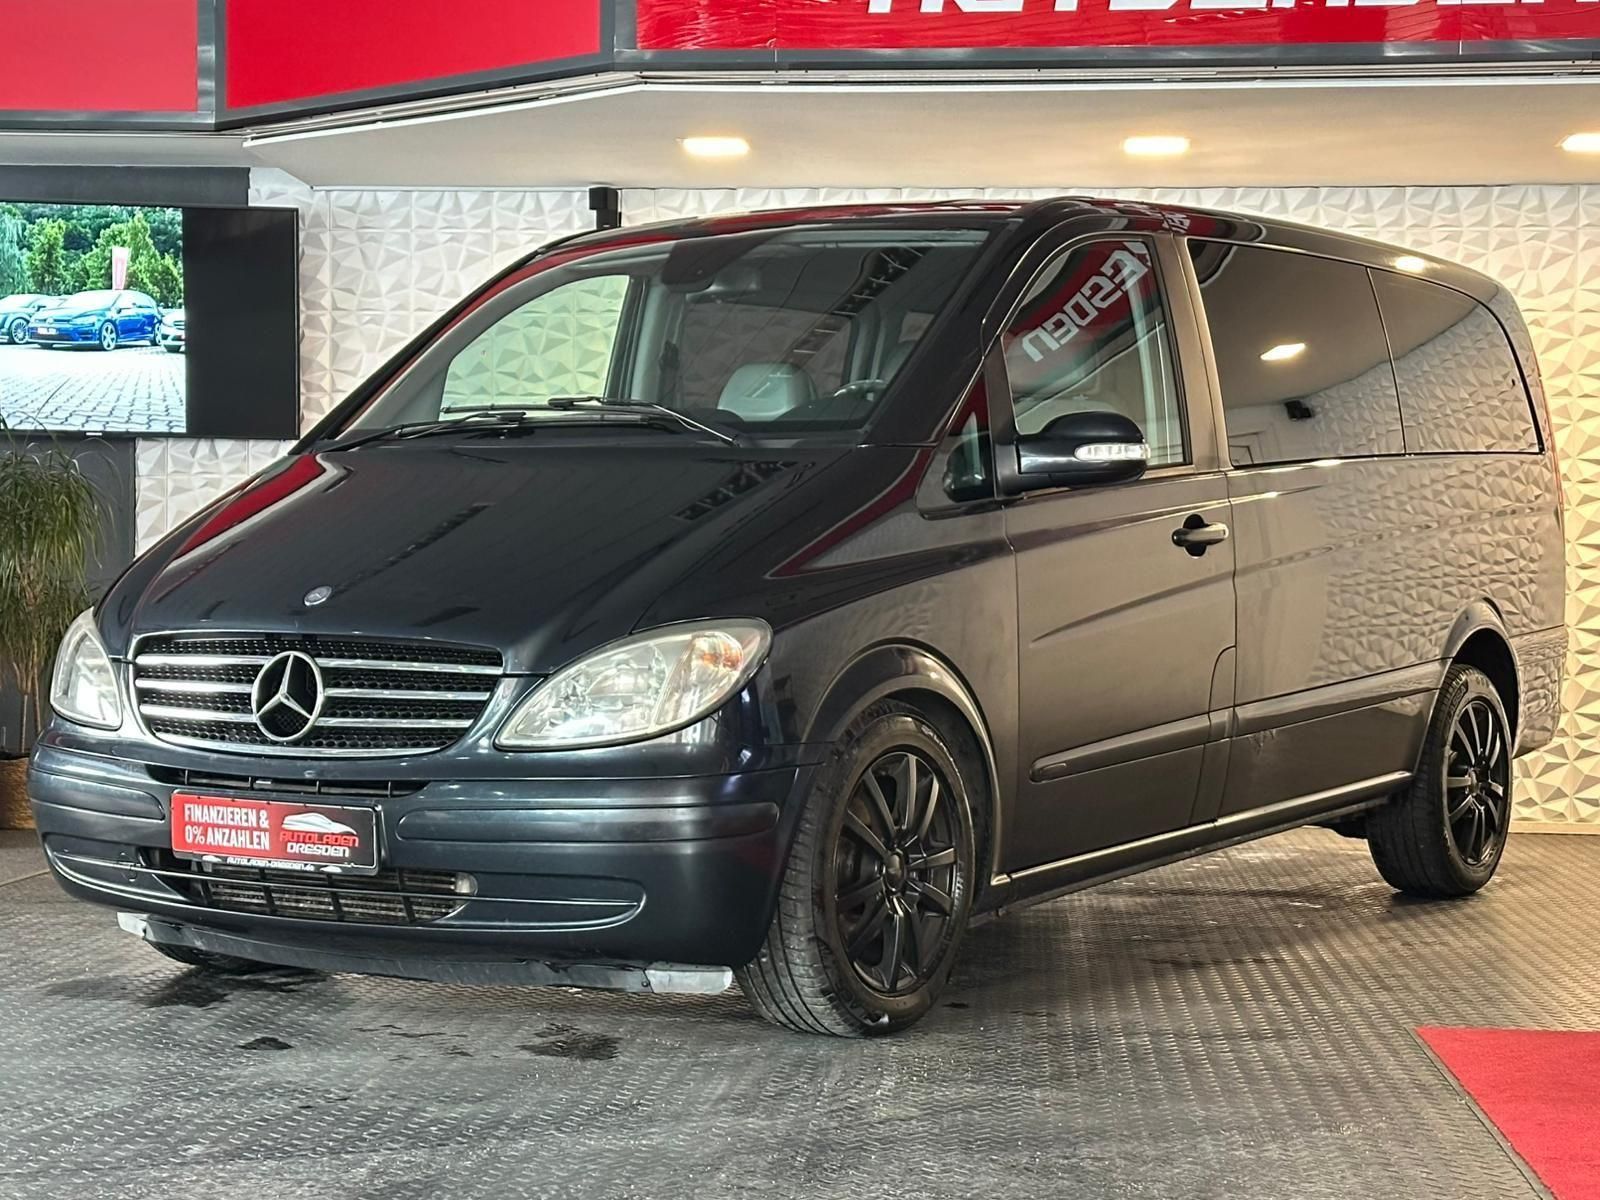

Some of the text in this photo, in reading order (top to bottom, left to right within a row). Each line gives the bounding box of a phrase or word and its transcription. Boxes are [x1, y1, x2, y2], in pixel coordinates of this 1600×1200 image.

[184, 804, 270, 828] FINANZIEREN &
[185, 826, 270, 850] 0% ANZAHLEN
[280, 831, 359, 847] AUTOLADEN
[287, 843, 349, 857] DRESDEN
